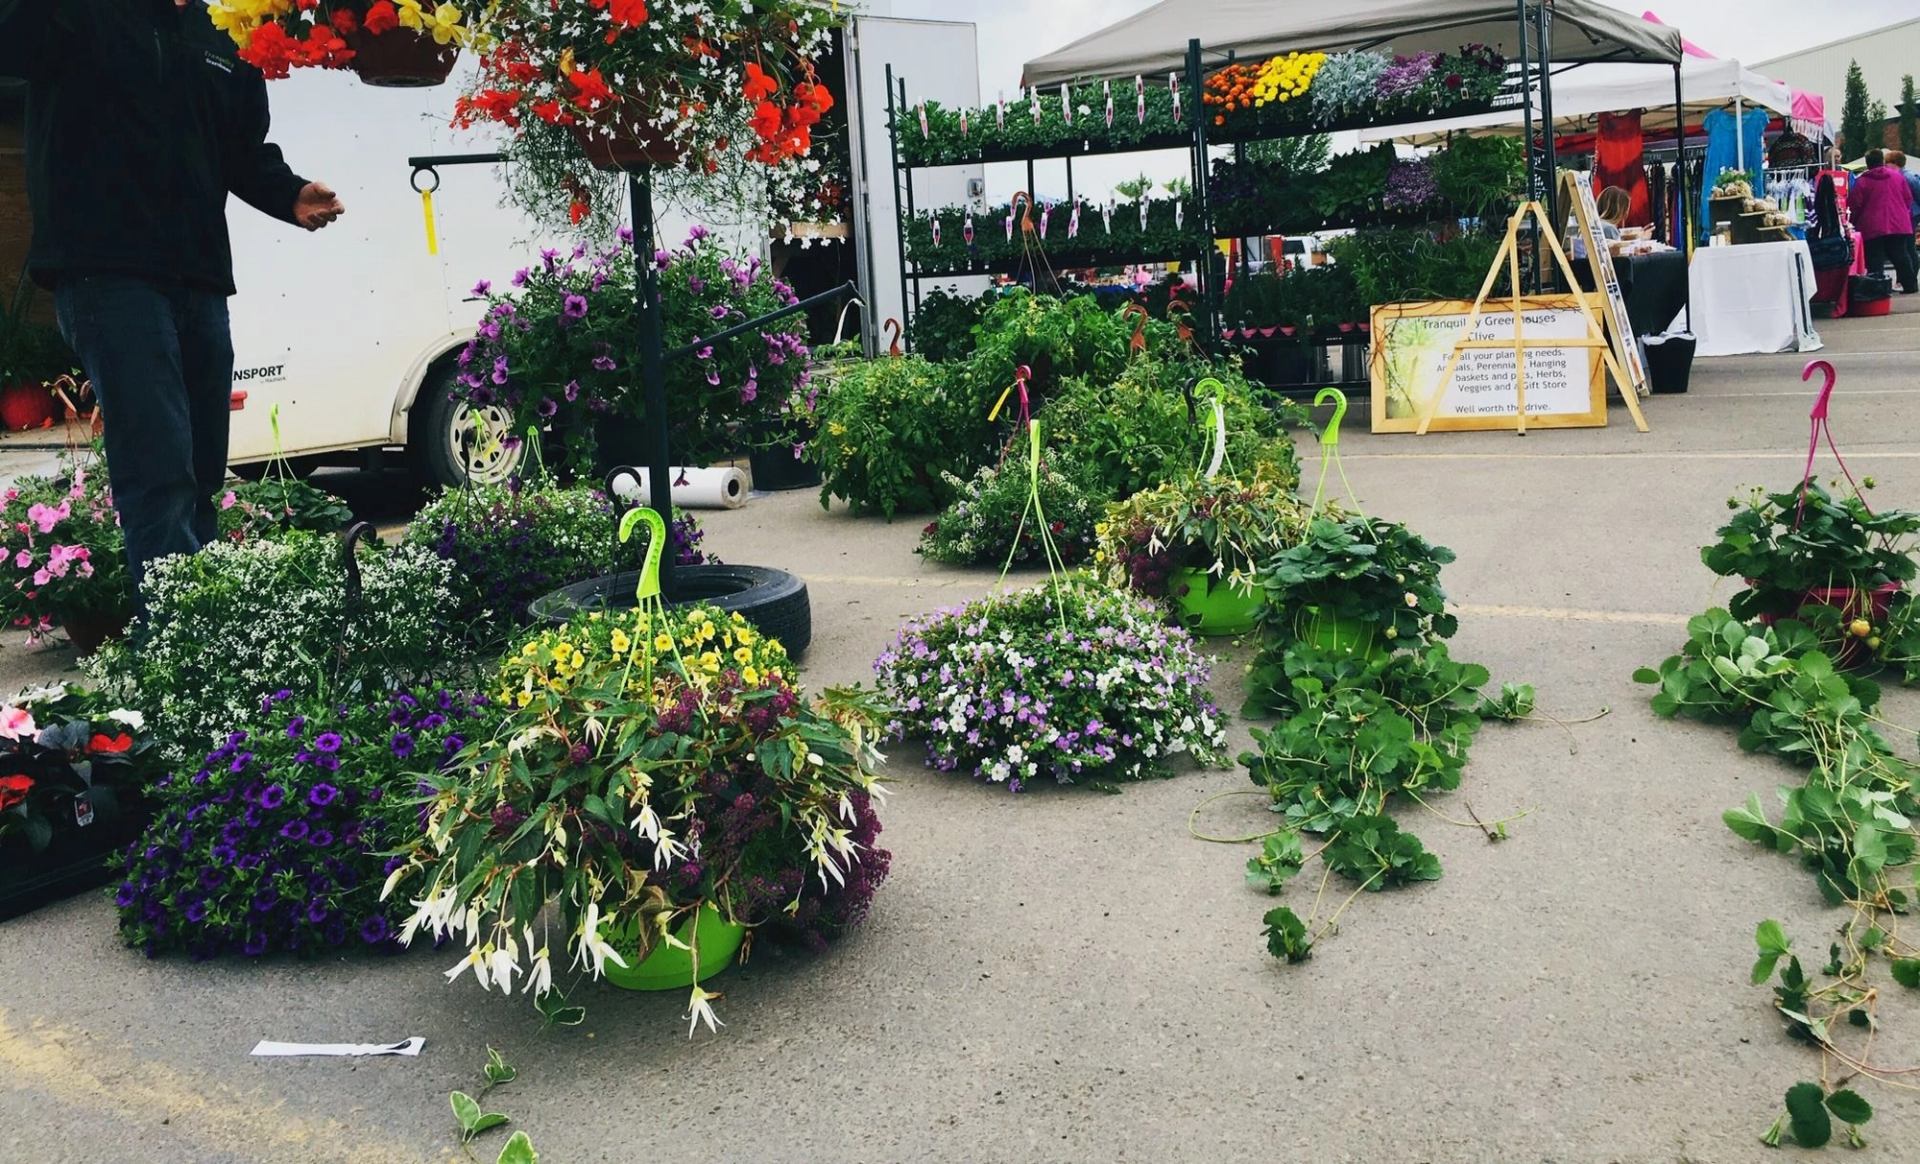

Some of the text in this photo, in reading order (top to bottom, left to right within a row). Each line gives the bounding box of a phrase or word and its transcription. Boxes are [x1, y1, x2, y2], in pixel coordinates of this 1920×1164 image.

[1423, 318, 1480, 329] Tranquily
[1443, 349, 1565, 362] Fo all your planng needs.
[1437, 359, 1566, 372] Anuals, Perennia, Hanging
[1456, 373, 1489, 382] baskets
[1492, 372, 1508, 381] and
[1510, 372, 1533, 381] ps,
[1458, 384, 1492, 394] Veggies
[1495, 383, 1511, 391] and
[1542, 380, 1567, 389] Store
[1455, 404, 1475, 413] Well
[1478, 404, 1504, 413] worth
[1525, 402, 1551, 411] drive.
